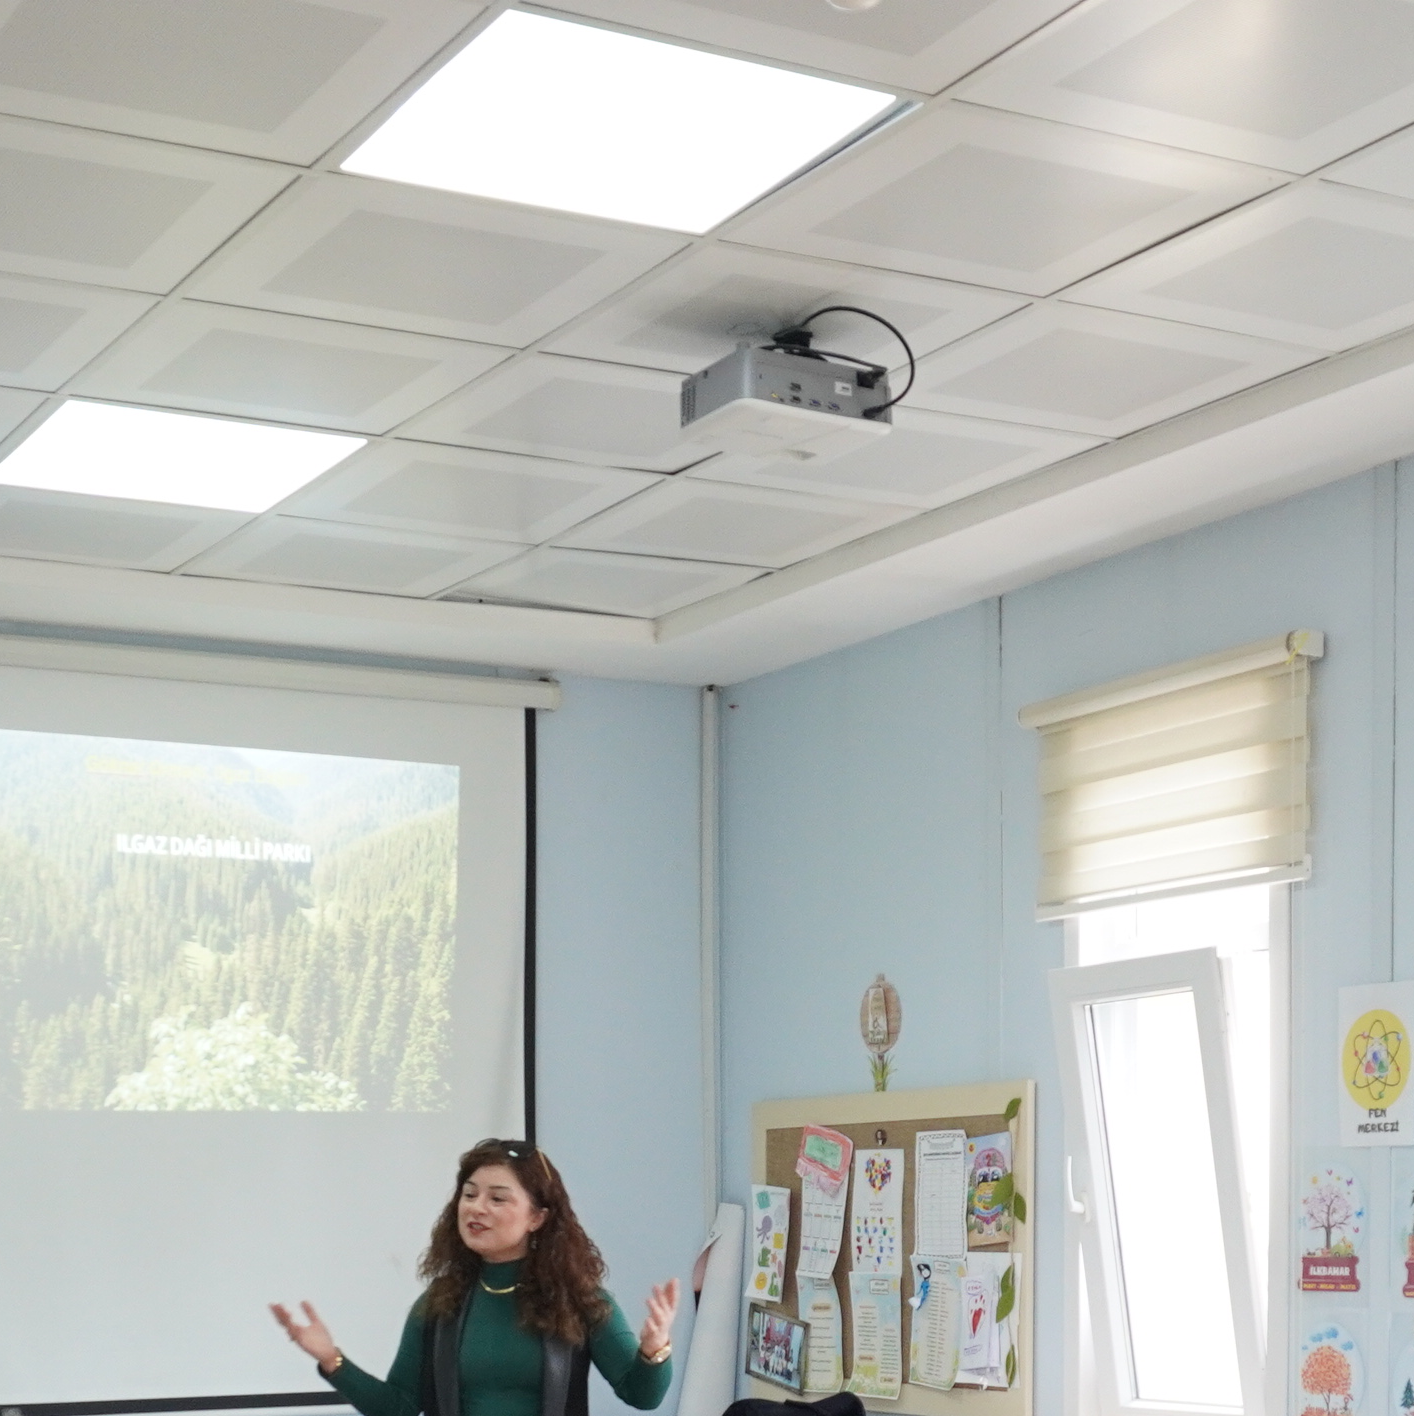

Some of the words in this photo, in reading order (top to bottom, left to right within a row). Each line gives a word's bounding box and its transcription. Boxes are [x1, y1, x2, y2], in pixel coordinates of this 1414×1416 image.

[116, 833, 168, 855] ILGAZ
[170, 833, 212, 858] DAĞI
[215, 835, 260, 860] MİLLİ
[262, 842, 311, 863] PARKI
[1368, 1107, 1387, 1119] FEN
